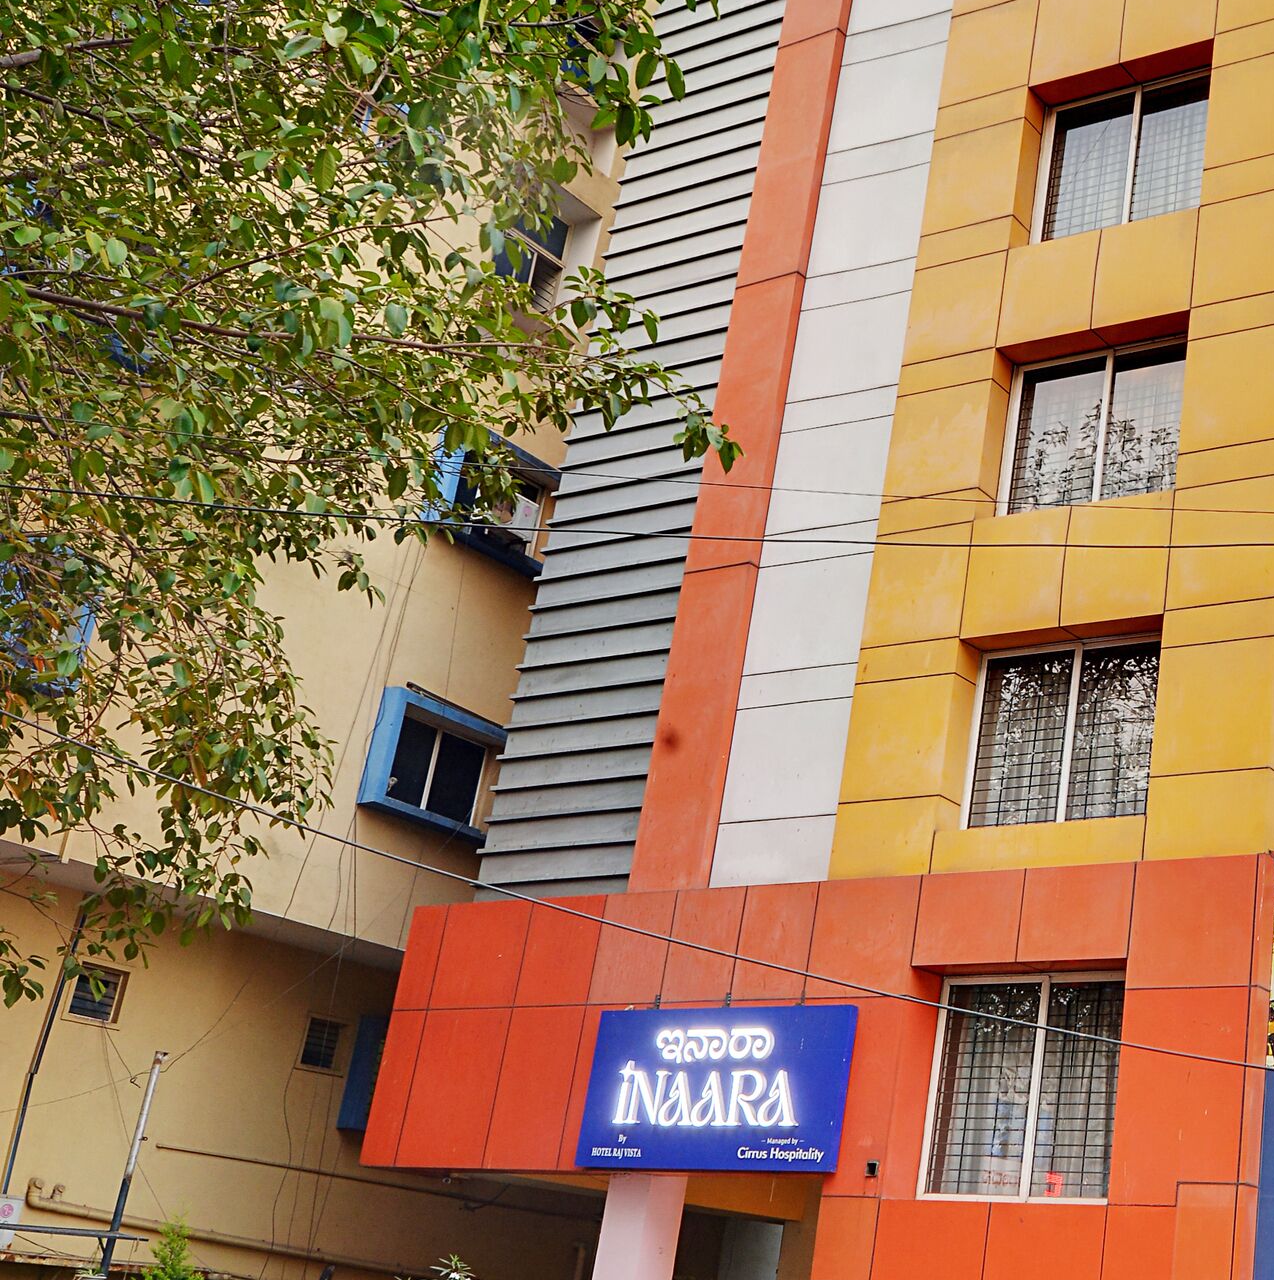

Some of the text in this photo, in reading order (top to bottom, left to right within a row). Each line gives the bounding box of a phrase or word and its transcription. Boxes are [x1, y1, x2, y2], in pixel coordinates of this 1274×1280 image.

[618, 1134, 627, 1144] By
[766, 1137, 799, 1146] Managed by
[591, 1147, 641, 1159] HOTEL RAJ VISTA
[737, 1146, 825, 1163] Cirrus Hospitality
